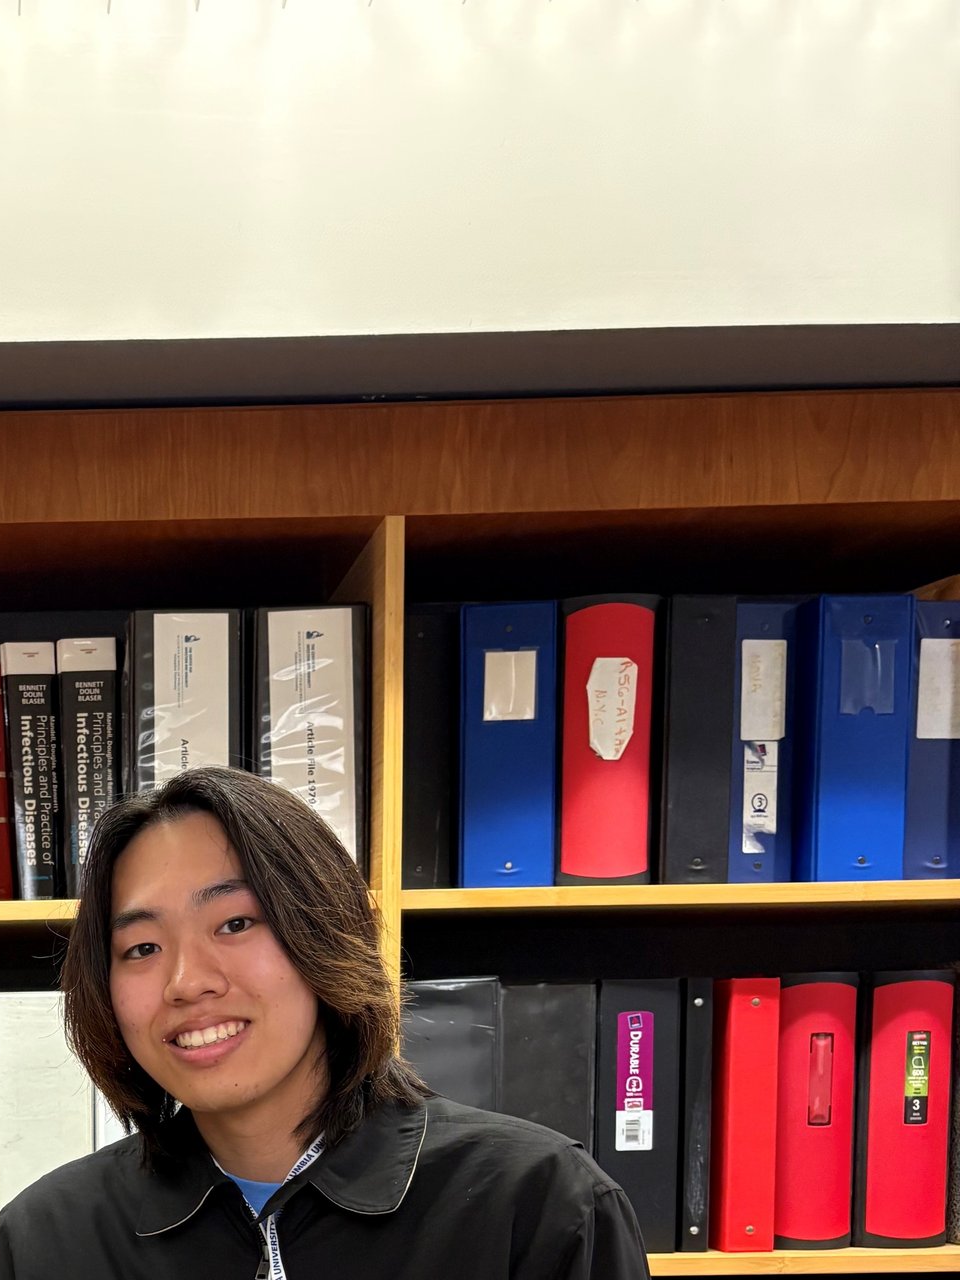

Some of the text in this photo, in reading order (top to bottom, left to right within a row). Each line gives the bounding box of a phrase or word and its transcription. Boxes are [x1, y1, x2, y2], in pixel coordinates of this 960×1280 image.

[19, 684, 46, 692] BENNETT
[90, 712, 105, 769] Principles
[105, 712, 113, 739] Mandell,
[306, 721, 315, 755] Article
[106, 740, 114, 767] Douglas,
[307, 758, 316, 776] File
[20, 715, 37, 866] Infectious Diseases
[36, 715, 54, 865] Principles and Practice of
[75, 712, 92, 864] Infectious Diseases
[93, 773, 105, 796] and
[630, 1031, 642, 1074] DURABLE
[912, 1099, 920, 1110] 3
[286, 1153, 315, 1181] UMBIA
[270, 1221, 281, 1275] UNIVERSITY
